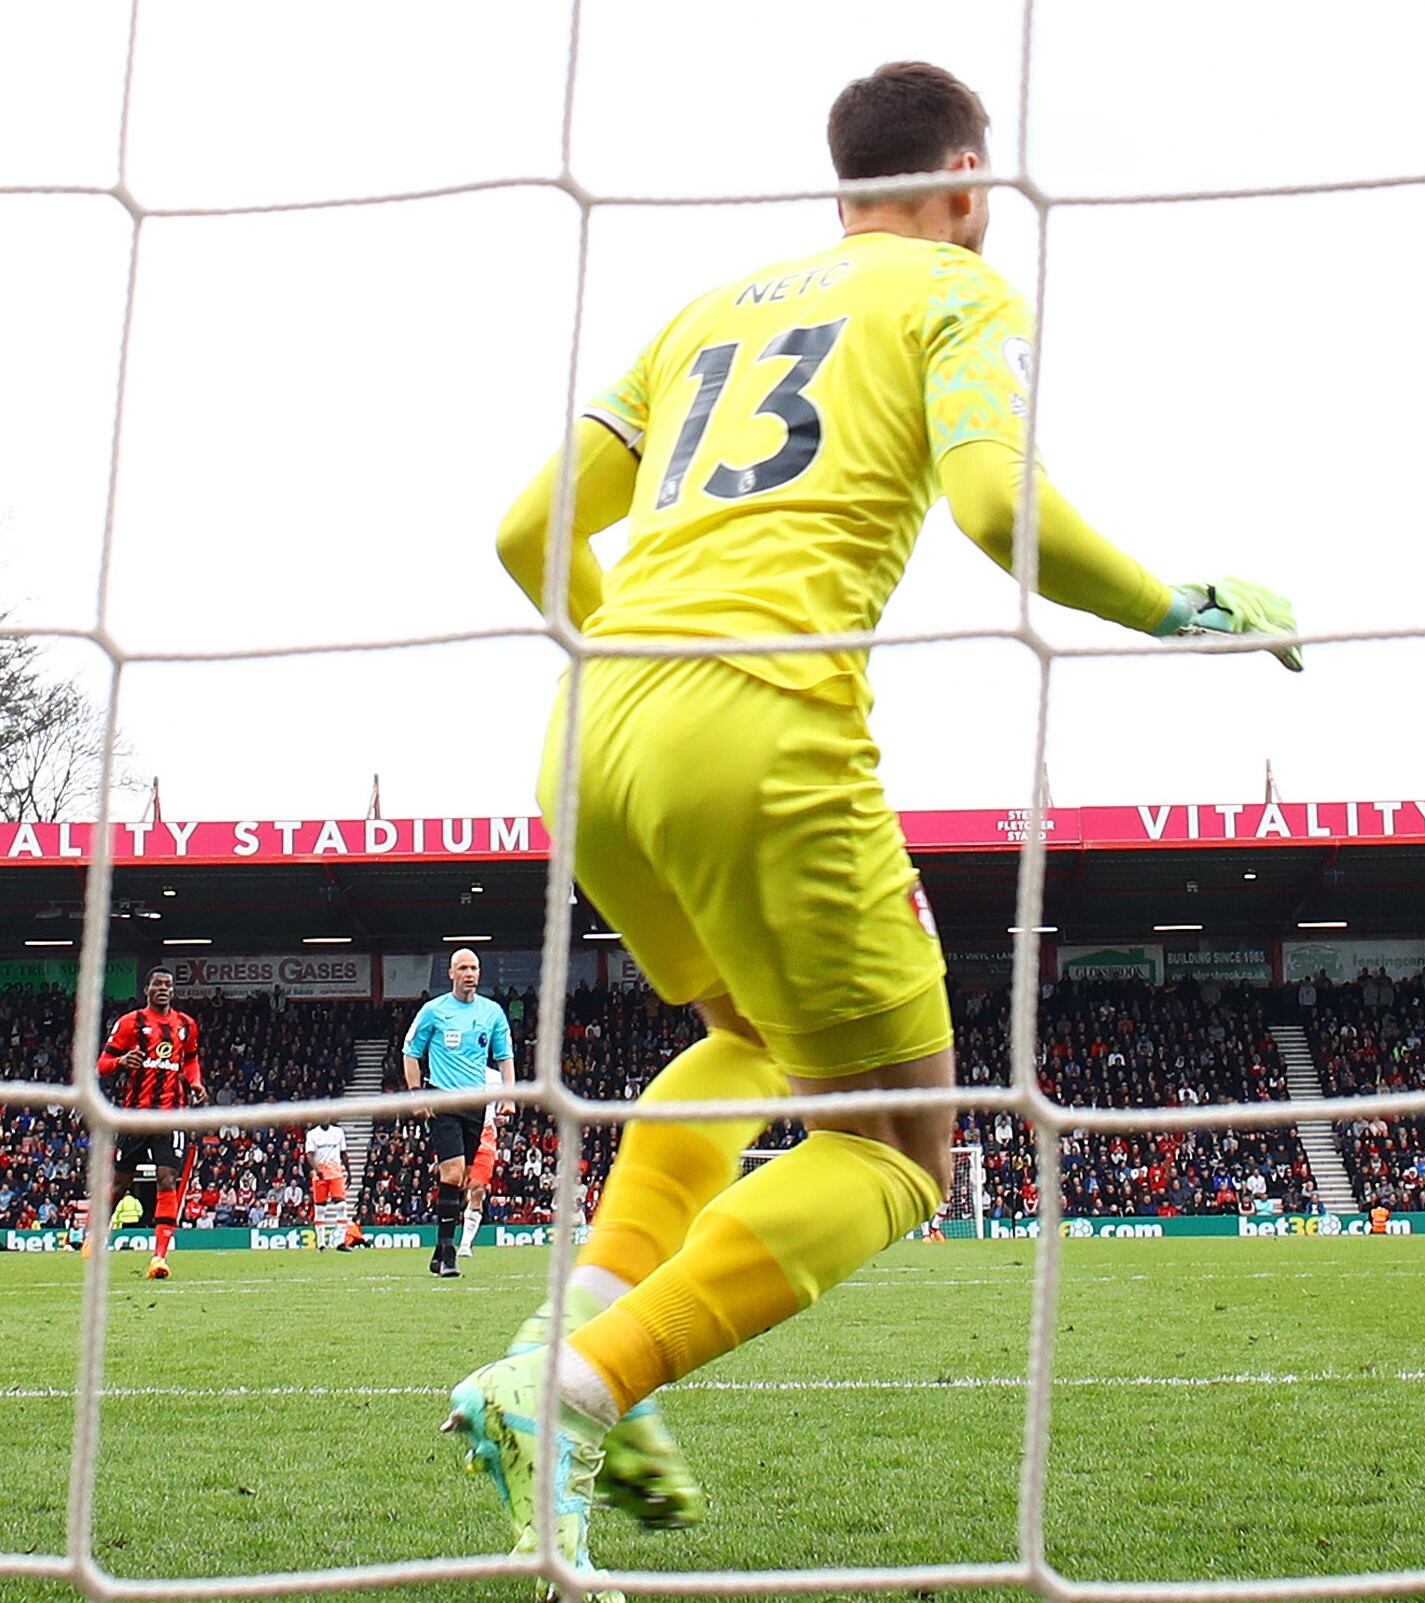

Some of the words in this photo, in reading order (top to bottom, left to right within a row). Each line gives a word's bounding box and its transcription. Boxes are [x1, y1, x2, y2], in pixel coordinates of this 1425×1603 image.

[656, 317, 849, 510] 13
[1008, 810, 1044, 820] STE
[997, 820, 1055, 832] FLETCER
[8, 823, 199, 857] ALTY
[233, 817, 530, 856] STADIUM
[1007, 831, 1047, 842] STAD
[1168, 951, 1212, 965] BUILDING
[1214, 951, 1242, 964] SINCE
[175, 958, 273, 985] EXPRESS
[278, 957, 358, 984] GASES
